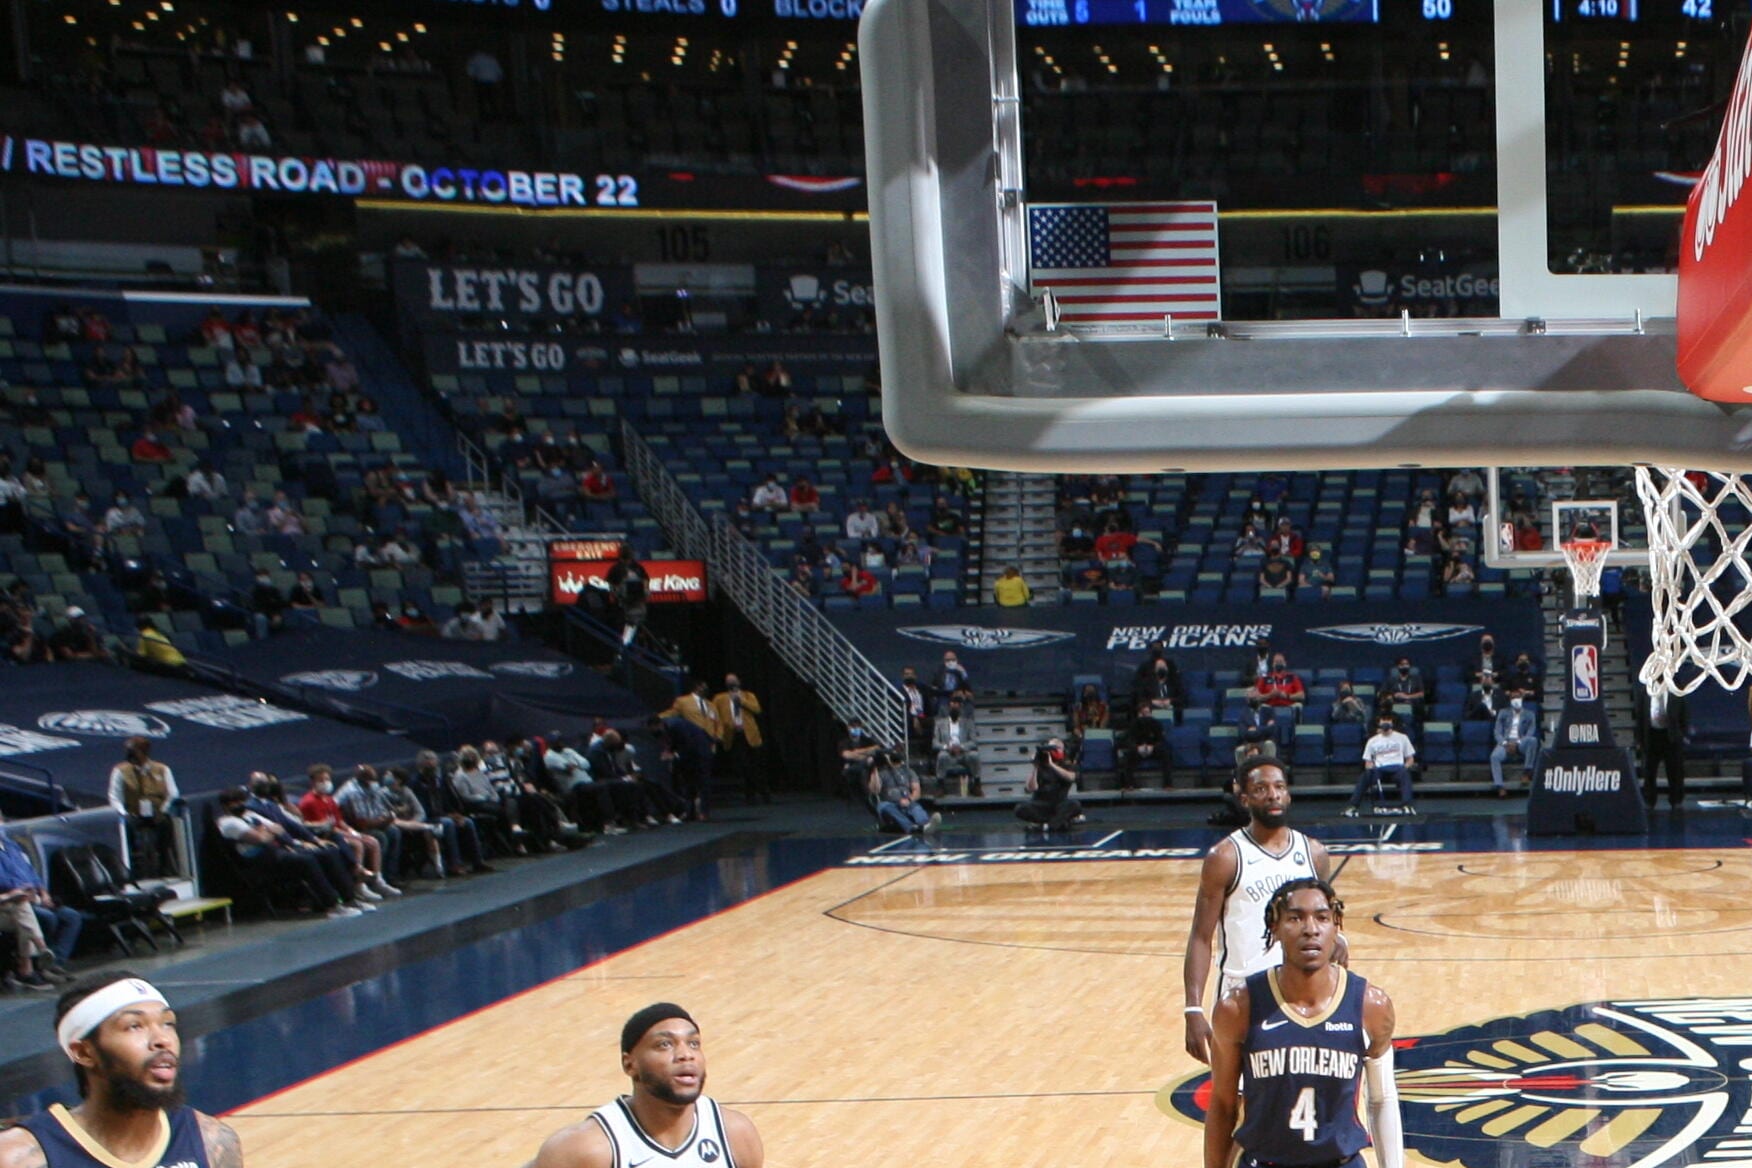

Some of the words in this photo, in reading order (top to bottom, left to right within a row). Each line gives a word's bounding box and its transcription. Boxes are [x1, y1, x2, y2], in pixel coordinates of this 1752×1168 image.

[775, 0, 863, 19] BLOCK
[25, 139, 239, 188] RESTLESS
[250, 156, 366, 195] ROAD
[401, 164, 587, 206] OCTOBER
[595, 174, 639, 207] 22
[656, 224, 711, 263] 105
[1283, 224, 1329, 260] 106
[426, 267, 540, 313] LET'S
[546, 272, 604, 315] GO
[1400, 273, 1499, 298] SeatGee
[458, 340, 528, 369] LET'S
[529, 342, 565, 370] GO
[1106, 633, 1268, 650] PEICANS
[1112, 625, 1167, 642] NEW
[1173, 624, 1273, 637] ORLEANS
[1568, 724, 1600, 743] @NBA
[1544, 766, 1621, 796] #OnlyHere
[1249, 1047, 1287, 1079] NEW
[1289, 1046, 1358, 1080] ORLEANS
[1288, 1087, 1318, 1142] 4
